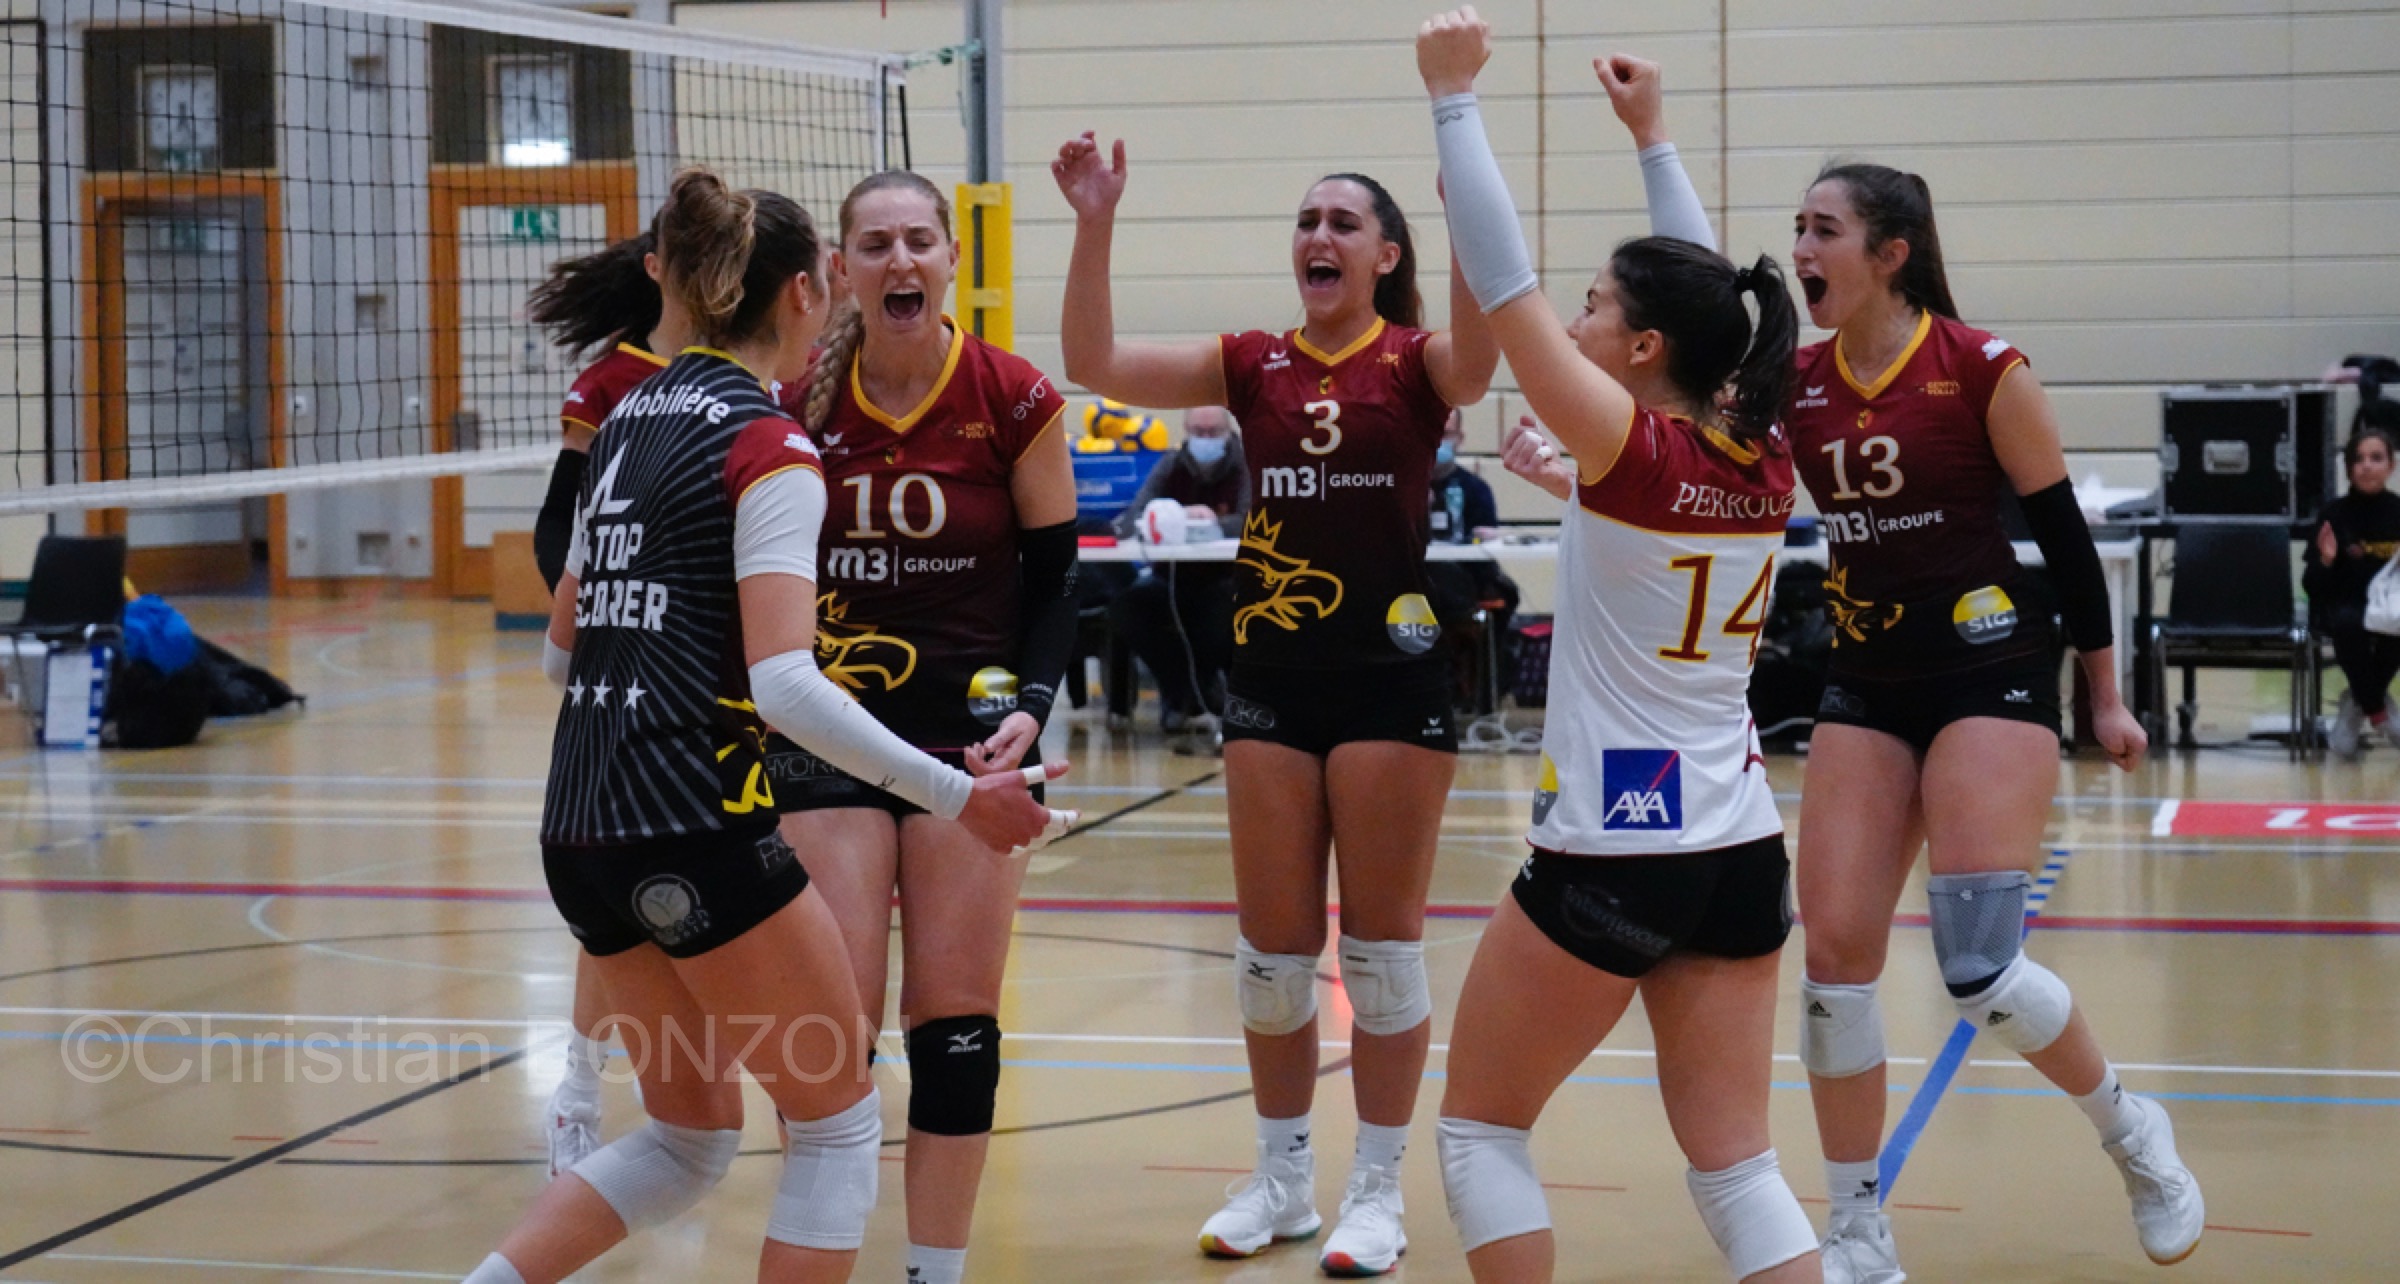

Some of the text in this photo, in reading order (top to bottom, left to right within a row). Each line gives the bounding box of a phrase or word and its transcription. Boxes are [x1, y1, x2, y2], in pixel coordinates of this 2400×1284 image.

[1300, 399, 1342, 455] 3
[1261, 466, 1395, 498] m3 GROUPE
[1820, 435, 1905, 500] 13
[842, 472, 947, 539] 10
[1822, 509, 1944, 544] m3 GROUPE
[594, 523, 643, 571] TOP
[827, 546, 976, 583] m3 GROUPE
[1657, 552, 1773, 668] 14
[1967, 612, 2009, 634] SIG
[1397, 622, 1435, 637] SIG
[979, 694, 1019, 713] SIG
[1604, 790, 1670, 823] AXA
